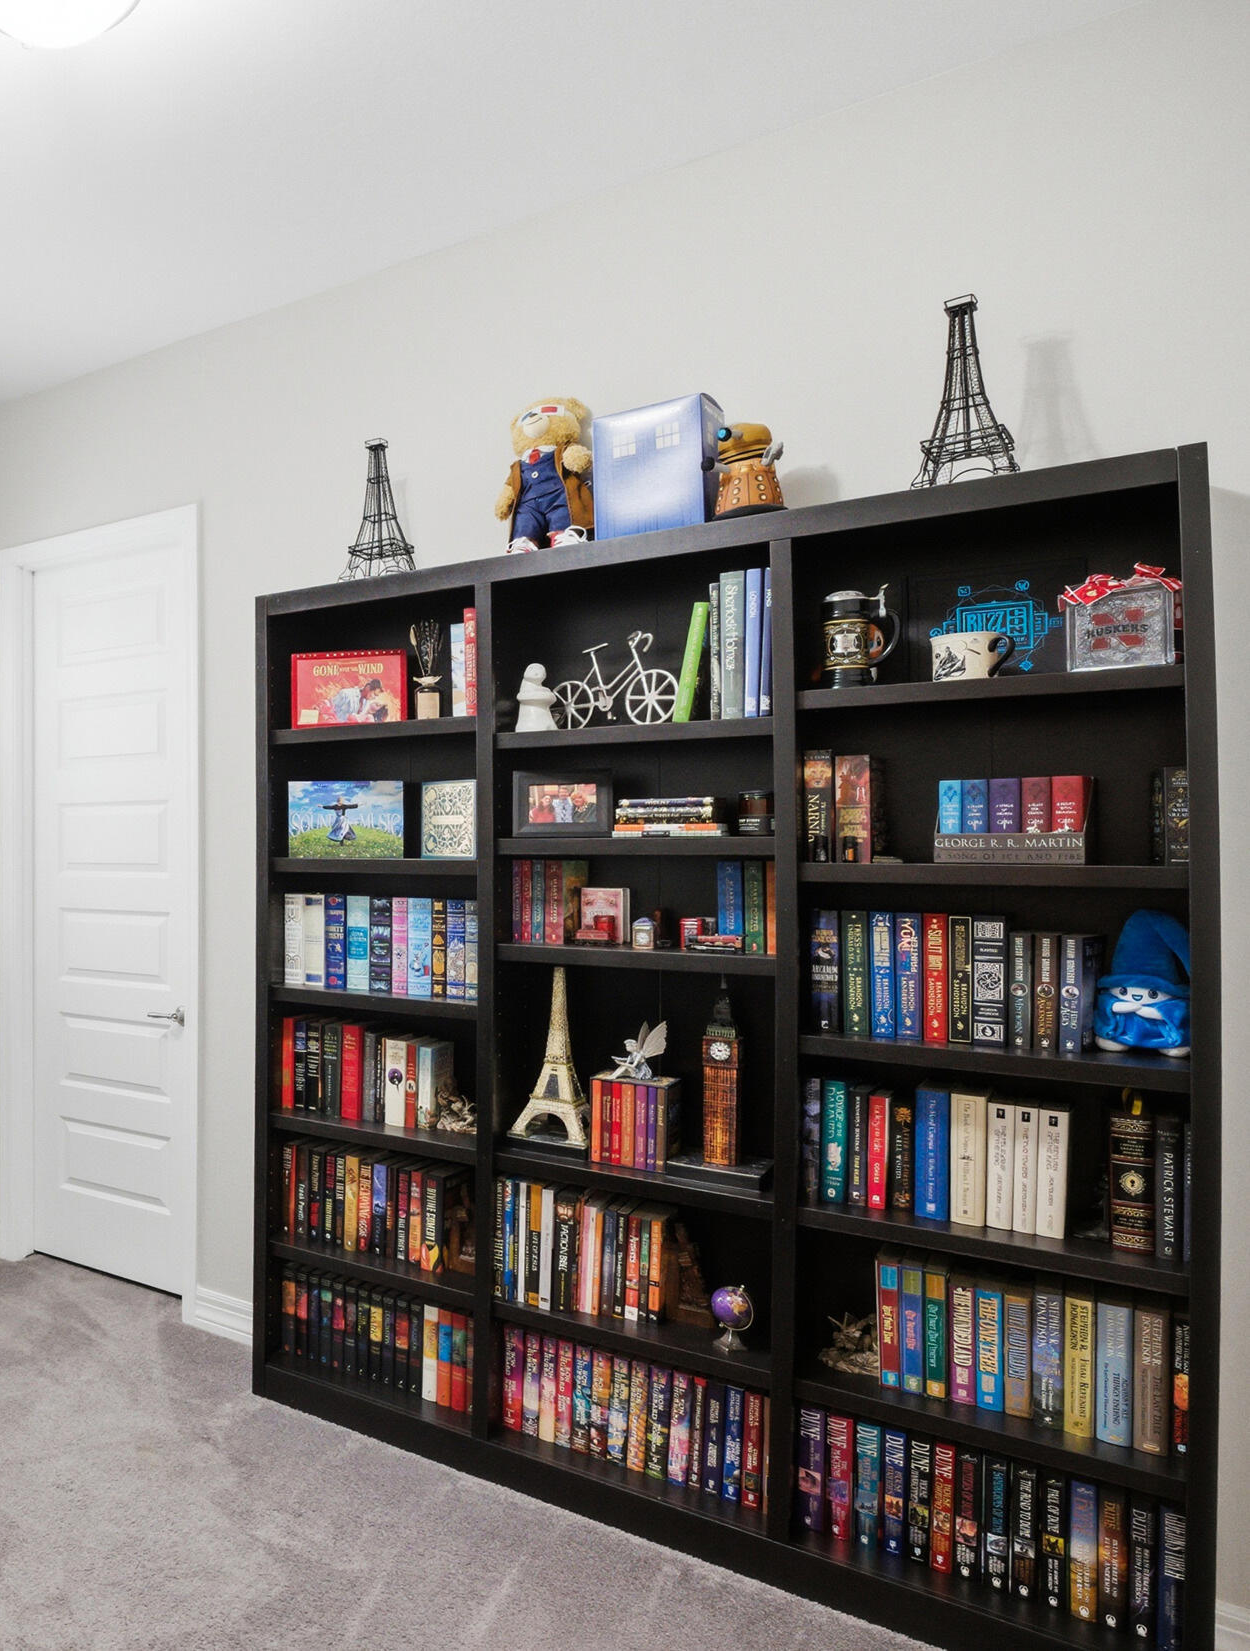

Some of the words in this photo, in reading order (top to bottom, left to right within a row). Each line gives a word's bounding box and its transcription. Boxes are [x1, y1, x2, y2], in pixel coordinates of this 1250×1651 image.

[725, 584, 739, 631] Sherlock
[749, 591, 757, 619] LONDON
[1086, 623, 1149, 640] HUSKERS
[725, 631, 738, 670] Holmes
[313, 663, 340, 677] GONE
[358, 662, 384, 675] WIND
[934, 838, 986, 848] GEORGE
[990, 838, 1003, 848] R.
[1006, 838, 1020, 848] R.
[1024, 837, 1083, 848] MARTIN
[1027, 852, 1052, 861] AND
[835, 1090, 845, 1122] VOYAGE
[1162, 1152, 1174, 1194] PATRICK
[425, 1187, 437, 1212] DIVINE
[1162, 1196, 1175, 1243] STEWART
[978, 1297, 998, 1320] THE
[1036, 1295, 1047, 1348] DONALDSON
[1048, 1300, 1060, 1337] STEPHEN
[1079, 1305, 1089, 1344] STEPHEN
[979, 1319, 998, 1343] ONE
[1069, 1303, 1079, 1351] DONALDSON
[1141, 1315, 1151, 1365] DONALDSON
[1152, 1316, 1163, 1359] STEPHEN
[953, 1343, 972, 1367] LAND
[978, 1341, 998, 1375] TREE
[1078, 1382, 1090, 1419] REVENANT
[800, 1409, 821, 1441] DUNE
[826, 1418, 848, 1449] DUNE
[856, 1424, 878, 1458] DUNE
[885, 1433, 904, 1467] DUNE
[911, 1440, 930, 1473] DUNE
[934, 1447, 953, 1480] DUNE
[1019, 1479, 1032, 1492] THE
[1019, 1491, 1032, 1511] ROAD
[1019, 1510, 1031, 1520] TO
[1047, 1504, 1060, 1516] OF
[1047, 1515, 1060, 1534] DUNE
[1019, 1519, 1031, 1538] DUNE
[1132, 1508, 1147, 1545] DUNE
